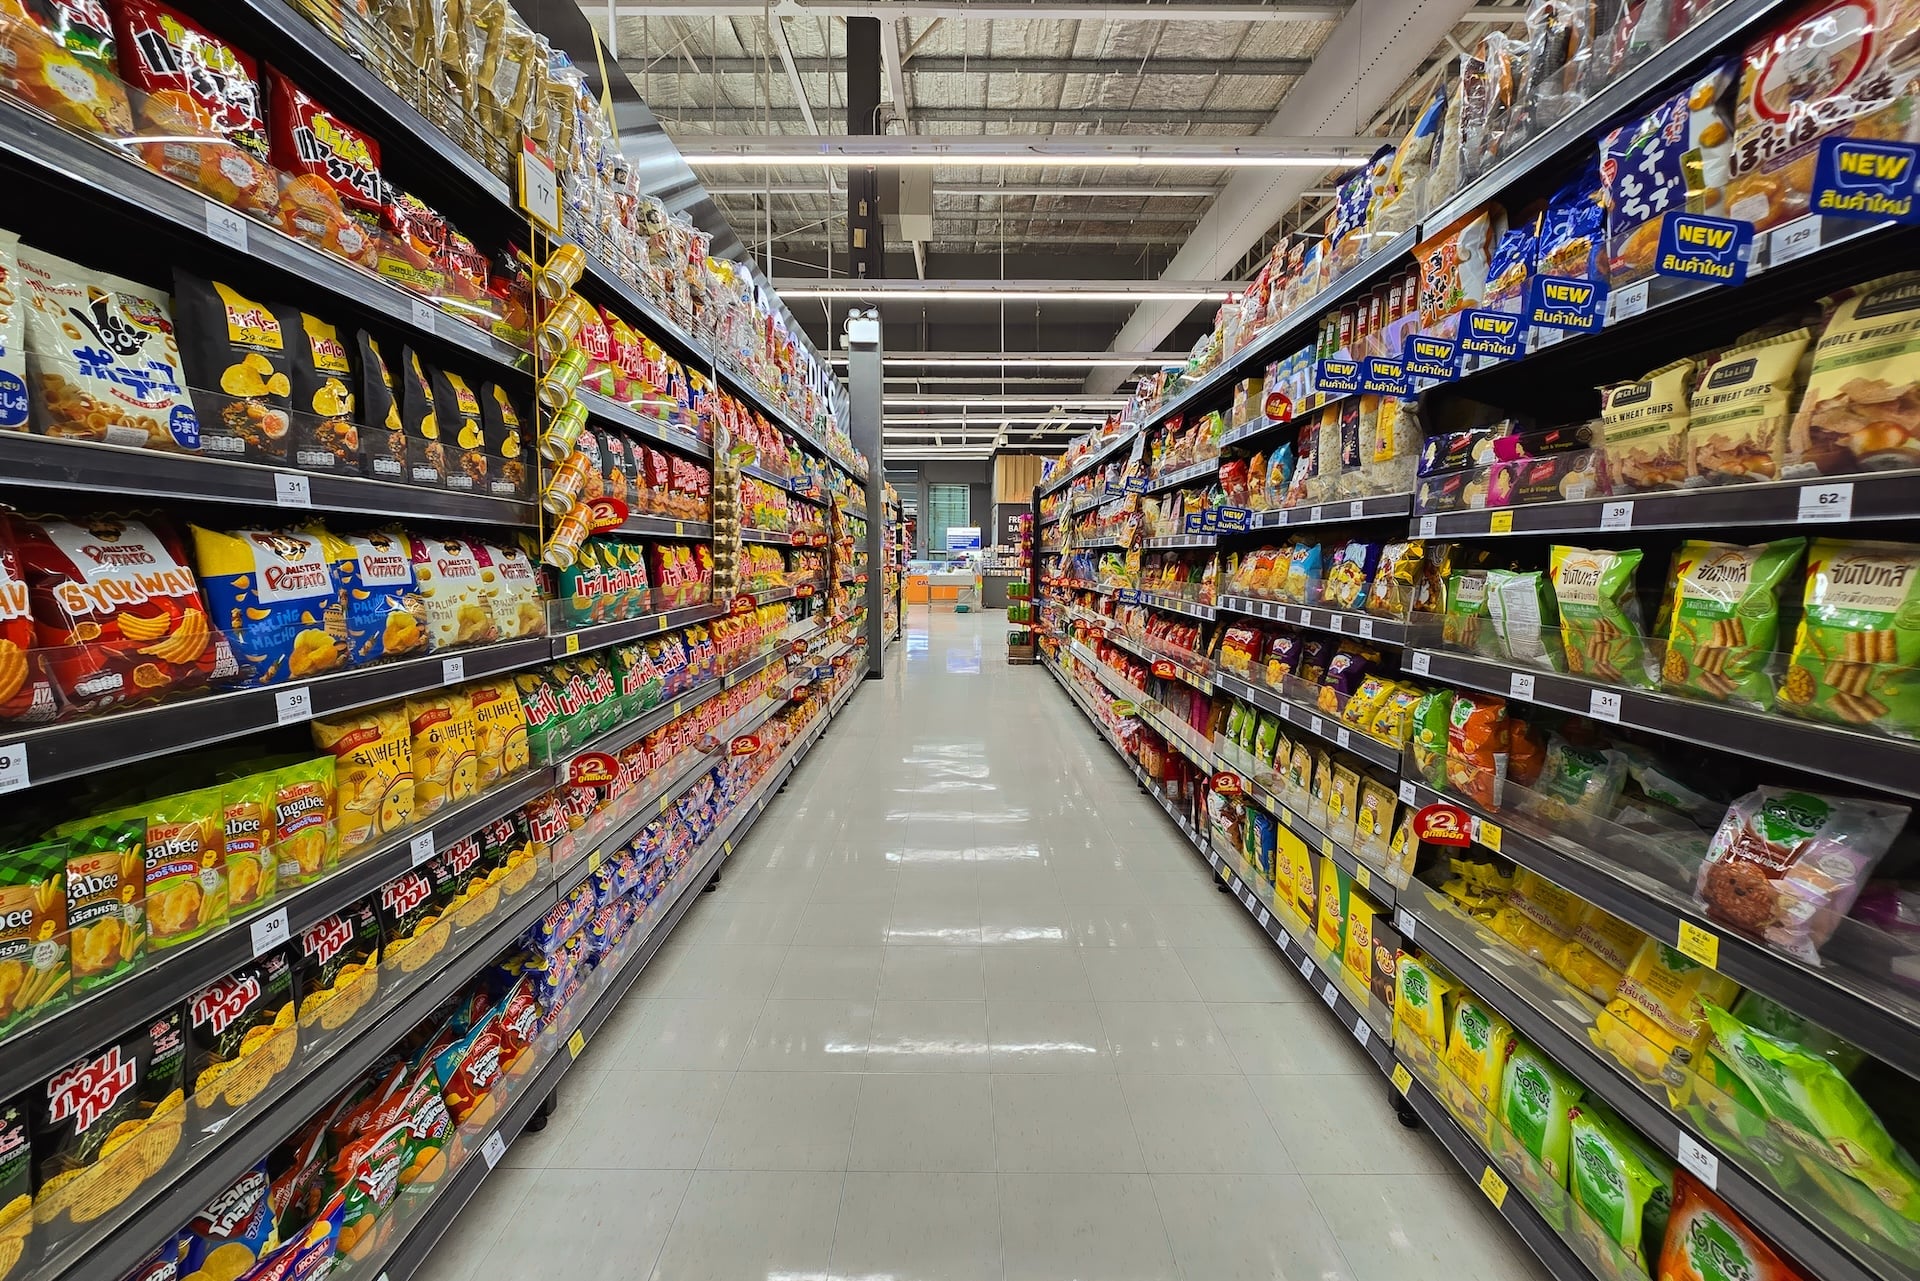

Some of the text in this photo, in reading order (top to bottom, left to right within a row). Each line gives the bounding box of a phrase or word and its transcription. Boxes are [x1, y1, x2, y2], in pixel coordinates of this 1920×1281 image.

[1840, 151, 1910, 180] NEW
[537, 183, 550, 204] 17
[1620, 173, 1651, 221] もち
[1818, 188, 1913, 216] สินค้าใหม่
[221, 216, 238, 233] 44
[1679, 224, 1733, 249] NEW
[1784, 229, 1810, 245] 129
[1662, 254, 1735, 279] สินค้าใหม่
[1546, 284, 1592, 304] NEW
[420, 309, 430, 318] 24
[1533, 308, 1594, 328] สินค้าใหม่
[1473, 317, 1516, 335] NEW
[1859, 321, 1910, 340] WHEAT
[1416, 342, 1451, 359] NEW
[1462, 338, 1517, 356] สินค้าใหม่
[1326, 363, 1355, 375] NEW
[1373, 363, 1401, 377] NEW
[1406, 361, 1453, 378] สินค้าใหม่
[1319, 379, 1358, 391] สินค้าใหม่
[1364, 380, 1407, 394] สินค้าใหม่
[1712, 390, 1742, 404] WHEAT
[1743, 383, 1772, 397] CHIPS
[1619, 408, 1645, 422] WHEAT
[1646, 402, 1674, 415] CHIPS
[288, 481, 301, 493] 31
[1535, 485, 1558, 494] Vinegar
[1819, 493, 1839, 505] 62
[594, 505, 608, 519] 2
[1008, 515, 1022, 524] FRE
[1223, 510, 1244, 520] NEW
[1613, 508, 1625, 517] 39
[82, 545, 156, 566] POTATO
[100, 545, 145, 553] MISTER
[286, 563, 322, 574] MISTER
[363, 555, 406, 578] POTATO
[373, 556, 403, 564] MISTER
[437, 558, 476, 577] POTATO
[444, 558, 472, 567] MISTER
[265, 565, 326, 592] POTATO
[427, 595, 458, 611] PALING
[252, 627, 297, 650] MACHO
[450, 663, 459, 673] 39
[1520, 678, 1529, 687] 20
[289, 695, 303, 707] 39
[1601, 697, 1612, 706] 31
[585, 760, 600, 774] 2
[276, 795, 324, 826] Jagabee
[1431, 813, 1451, 831] 2
[420, 839, 429, 849] 55
[146, 839, 199, 869] gabee
[265, 919, 280, 933] 30
[147, 1055, 184, 1080] SEAWE
[1692, 1148, 1708, 1165] 35
